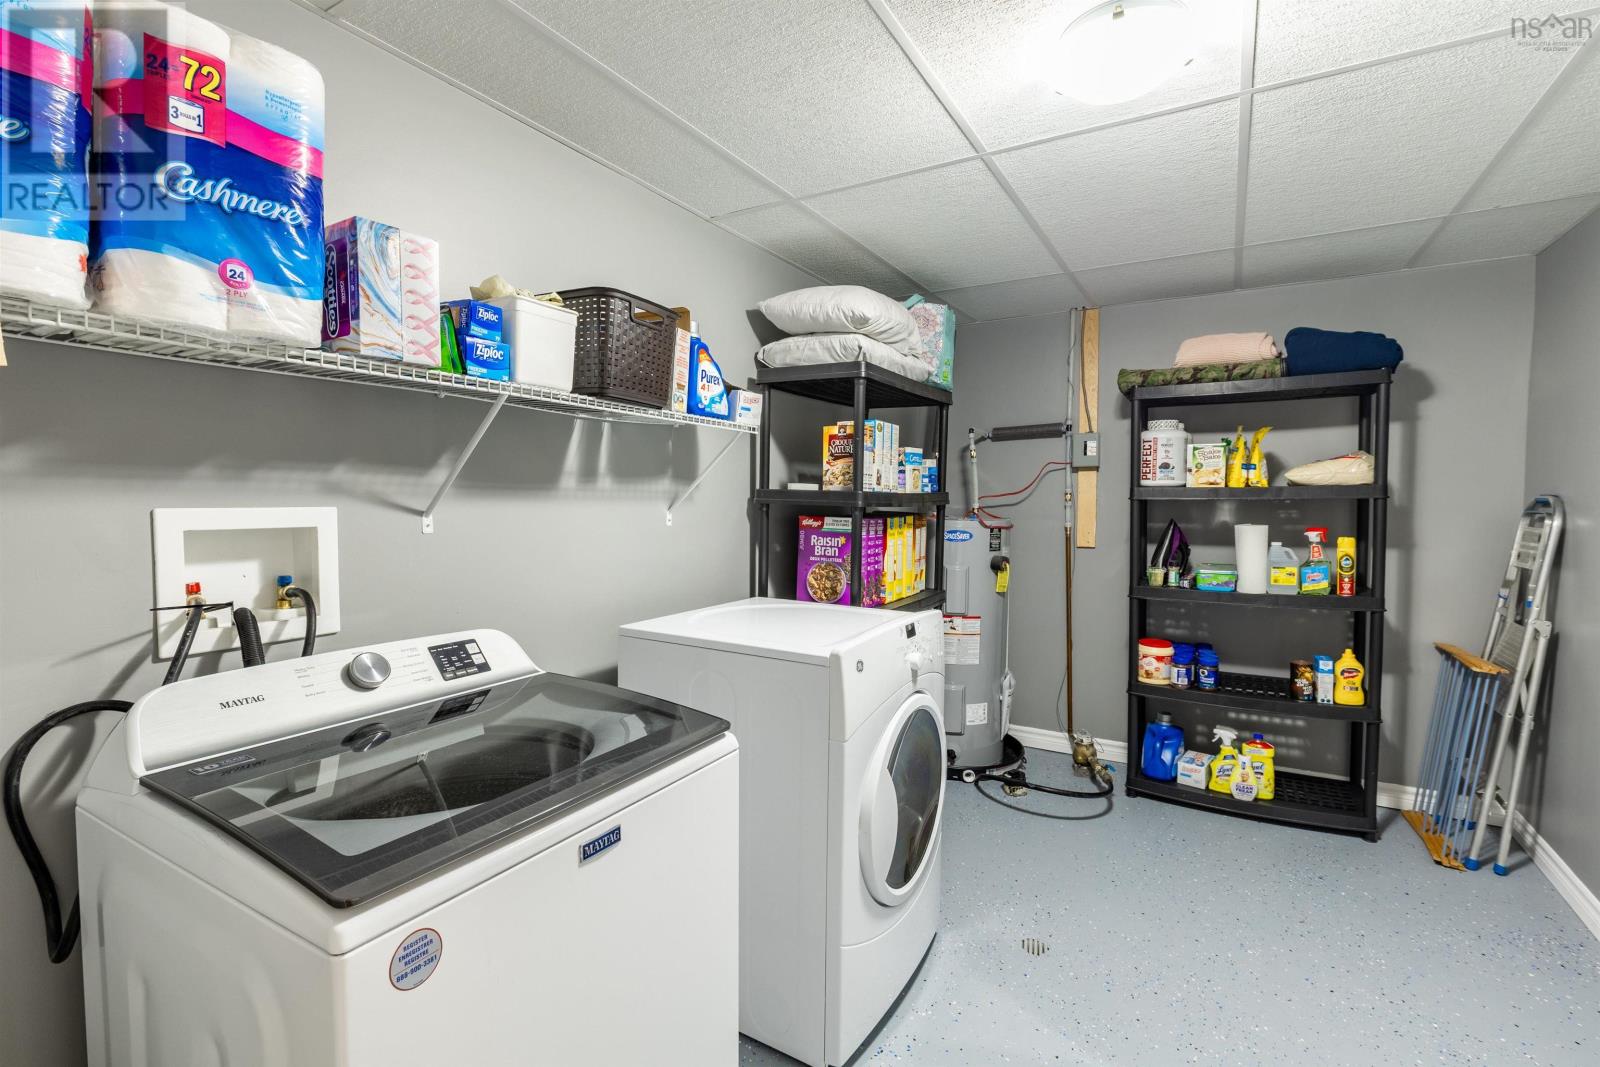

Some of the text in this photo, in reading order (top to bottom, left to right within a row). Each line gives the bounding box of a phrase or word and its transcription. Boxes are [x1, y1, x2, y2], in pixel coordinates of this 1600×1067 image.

[179, 54, 223, 102] 72
[170, 105, 179, 119] 3
[196, 113, 203, 127] 1
[155, 160, 306, 226] Cashmere
[228, 268, 246, 281] 24
[325, 250, 337, 332] Scotties
[478, 306, 499, 322] Ziploc
[475, 343, 504, 360] Ziploc
[700, 369, 720, 386] Purex
[1141, 438, 1152, 481] PERFECT
[810, 535, 841, 547] Raisin
[814, 546, 839, 557] Bran
[219, 695, 265, 711] MAYTAG
[583, 832, 621, 858] MAYTAG
[398, 938, 434, 963] ENREGISTRER
[403, 934, 428, 952] REGISTER
